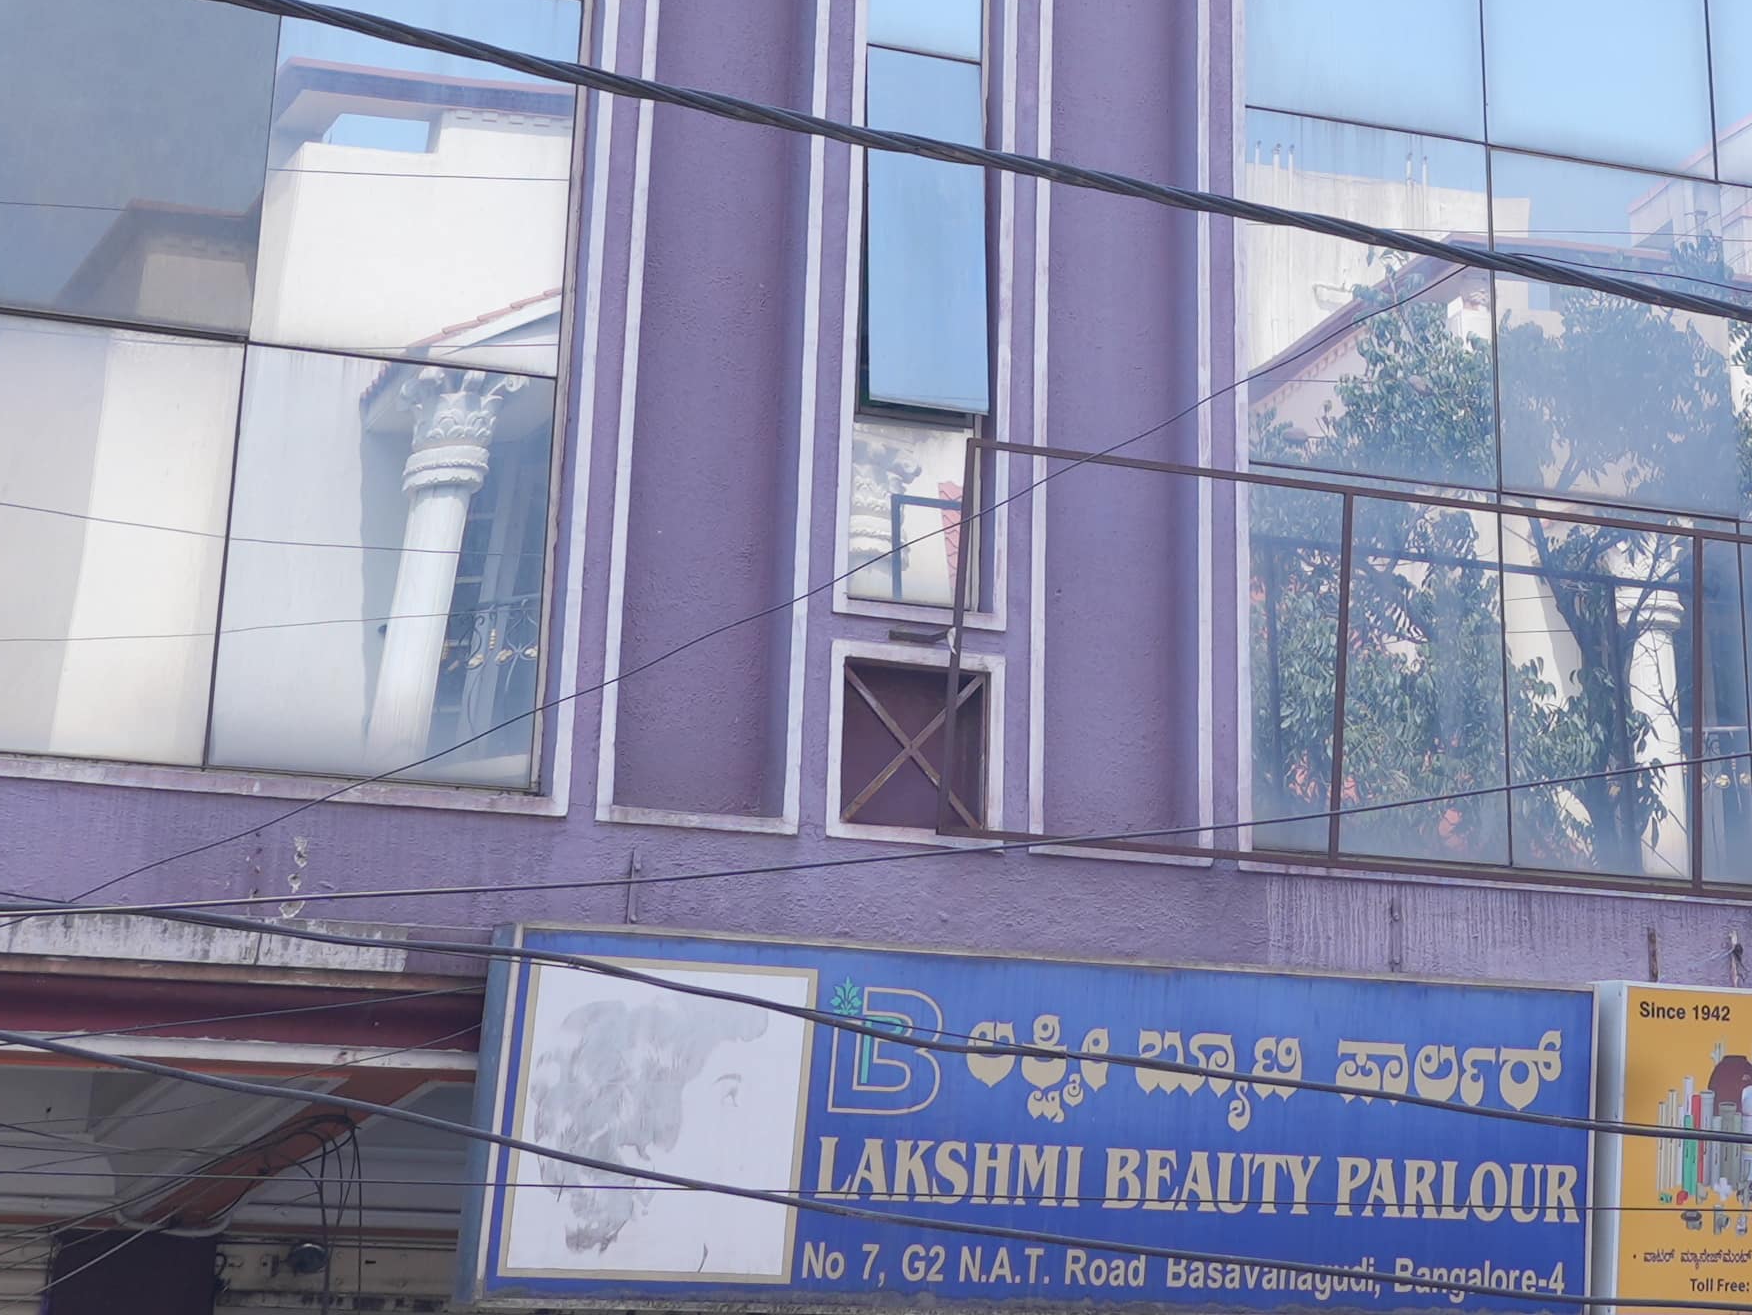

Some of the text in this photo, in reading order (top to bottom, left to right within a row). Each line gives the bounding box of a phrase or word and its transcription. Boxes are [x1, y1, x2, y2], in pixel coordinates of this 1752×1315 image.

[1639, 1001, 1731, 1021] Since 1942
[1335, 1029, 1563, 1111] ಪಾರ್ಲರ್
[815, 1135, 1580, 1224] LAKSHMI BEAUTY PARLOUR
[801, 1241, 1565, 1302] No 7, G2 N.A.T. Road Basavanagudi, Bangalore-4
[1690, 1278, 1714, 1292] Toll
[1717, 1279, 1750, 1293] Free:
